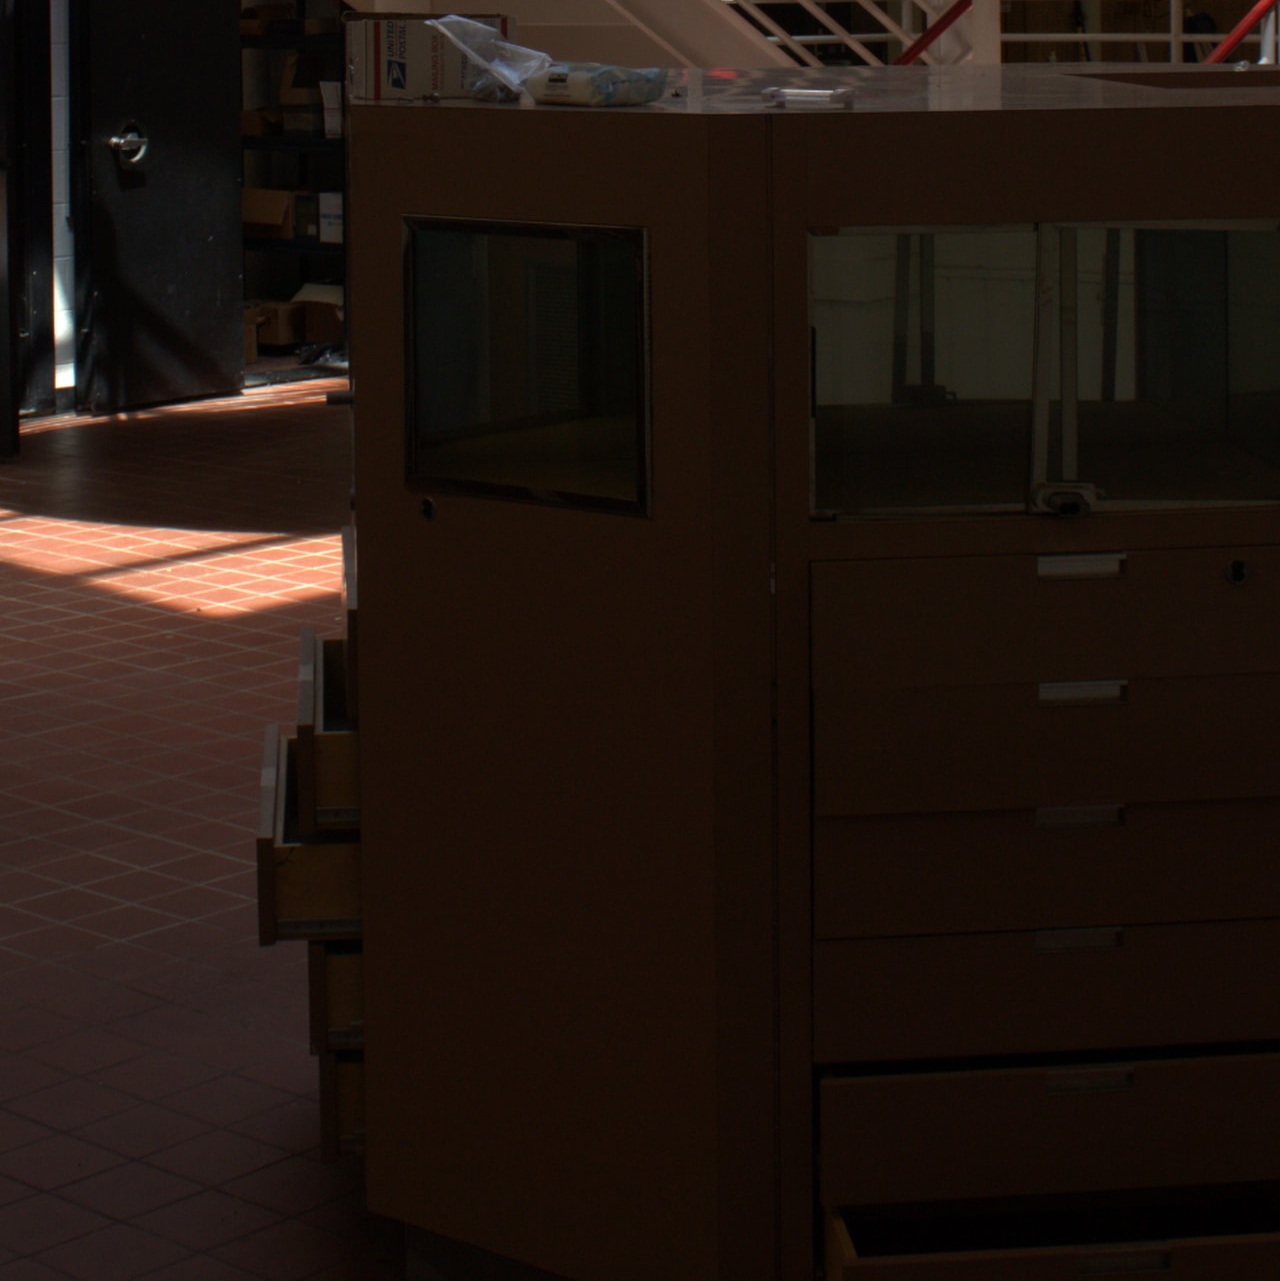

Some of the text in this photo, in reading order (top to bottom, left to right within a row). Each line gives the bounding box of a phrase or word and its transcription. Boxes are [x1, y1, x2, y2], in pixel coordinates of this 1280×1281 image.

[386, 21, 395, 58] UNITED
[398, 24, 407, 60] POSTAL
[431, 34, 440, 91] MAILING BOX
